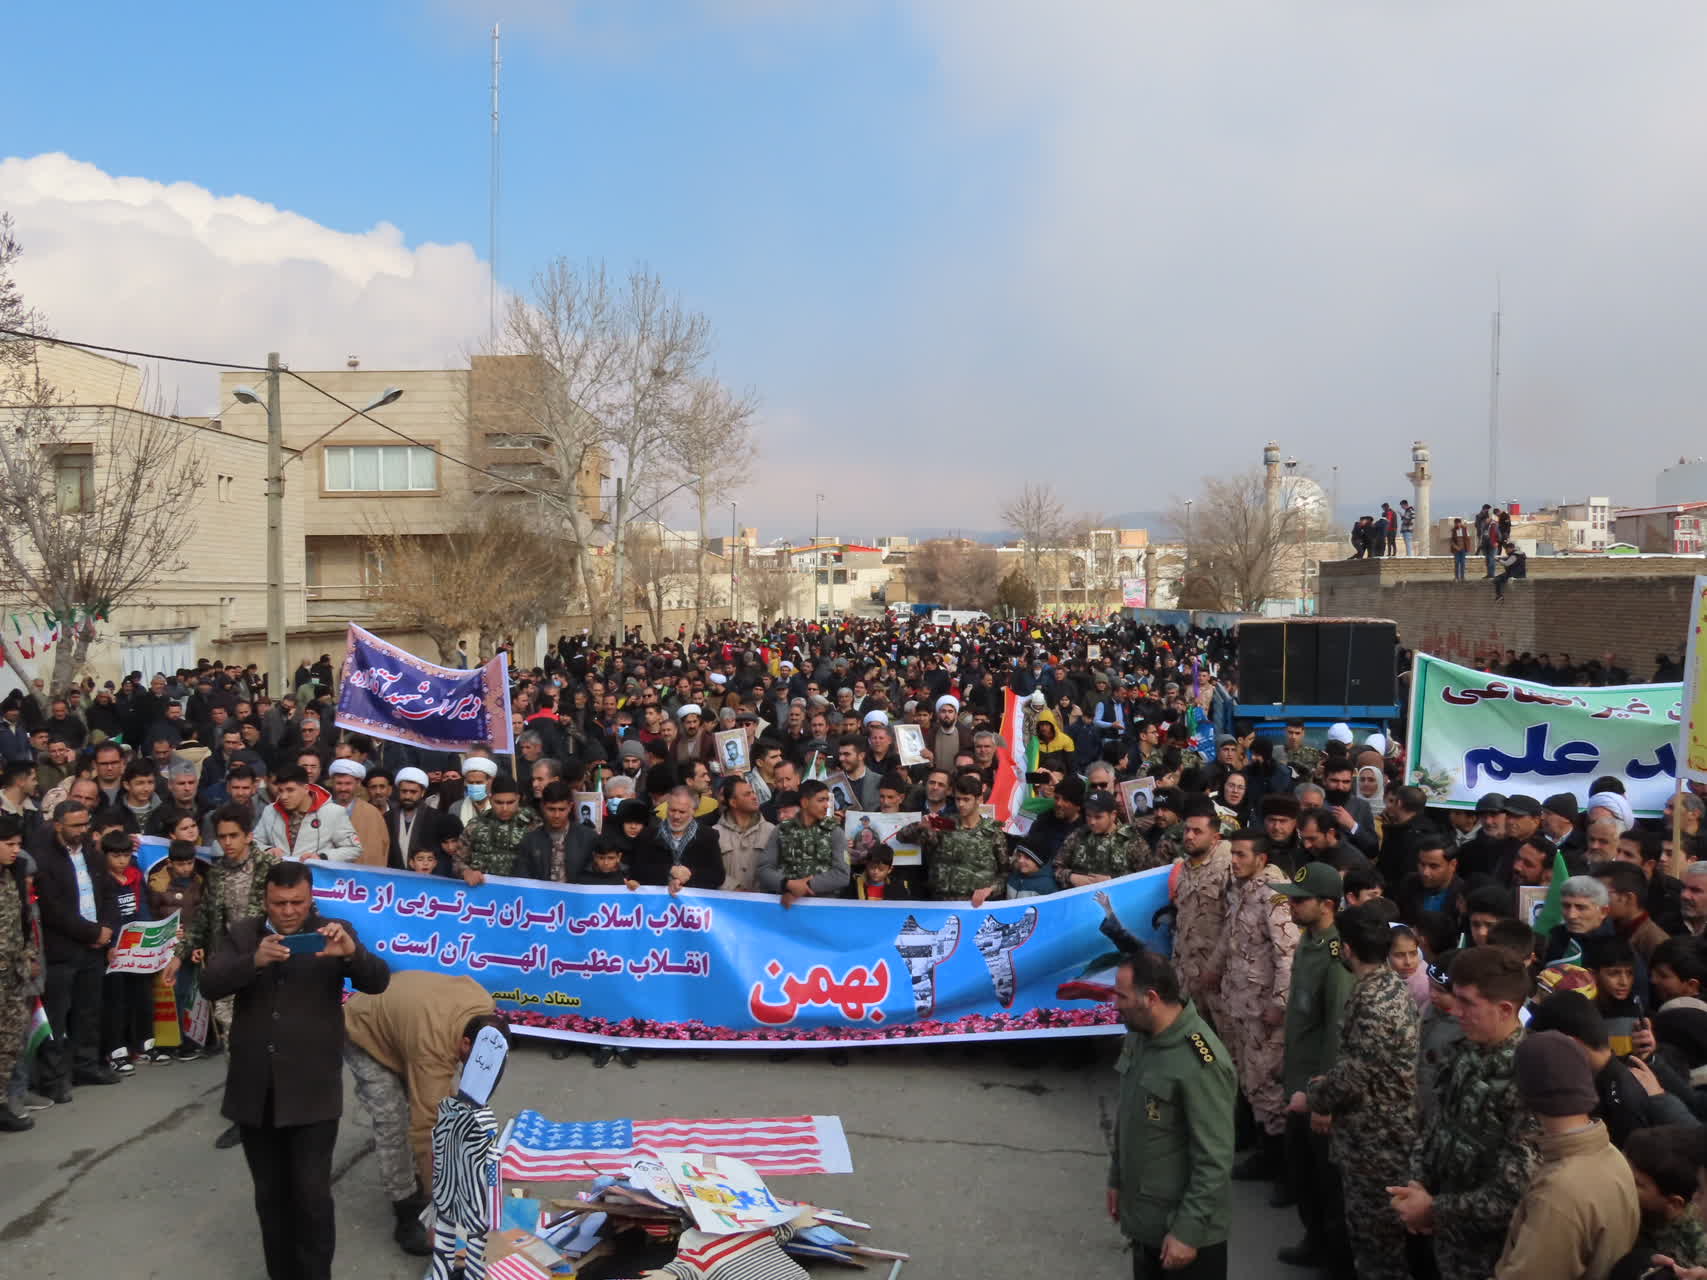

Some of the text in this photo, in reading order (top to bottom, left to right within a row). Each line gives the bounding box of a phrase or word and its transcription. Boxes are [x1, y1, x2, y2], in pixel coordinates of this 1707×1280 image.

[1590, 697, 1651, 719] غیر
[1465, 722, 1600, 789] علم
[369, 882, 394, 913] از
[397, 892, 496, 926] پرتویی
[499, 896, 564, 931] ایران
[568, 903, 643, 934] اسلامی
[648, 903, 712, 935] انقلاب
[440, 933, 474, 966] آن
[468, 943, 547, 974] الهی
[551, 948, 624, 978] عظیم
[628, 948, 710, 981] انقلاب
[544, 991, 581, 1007] ستاد
[748, 957, 889, 1025] بهمن
